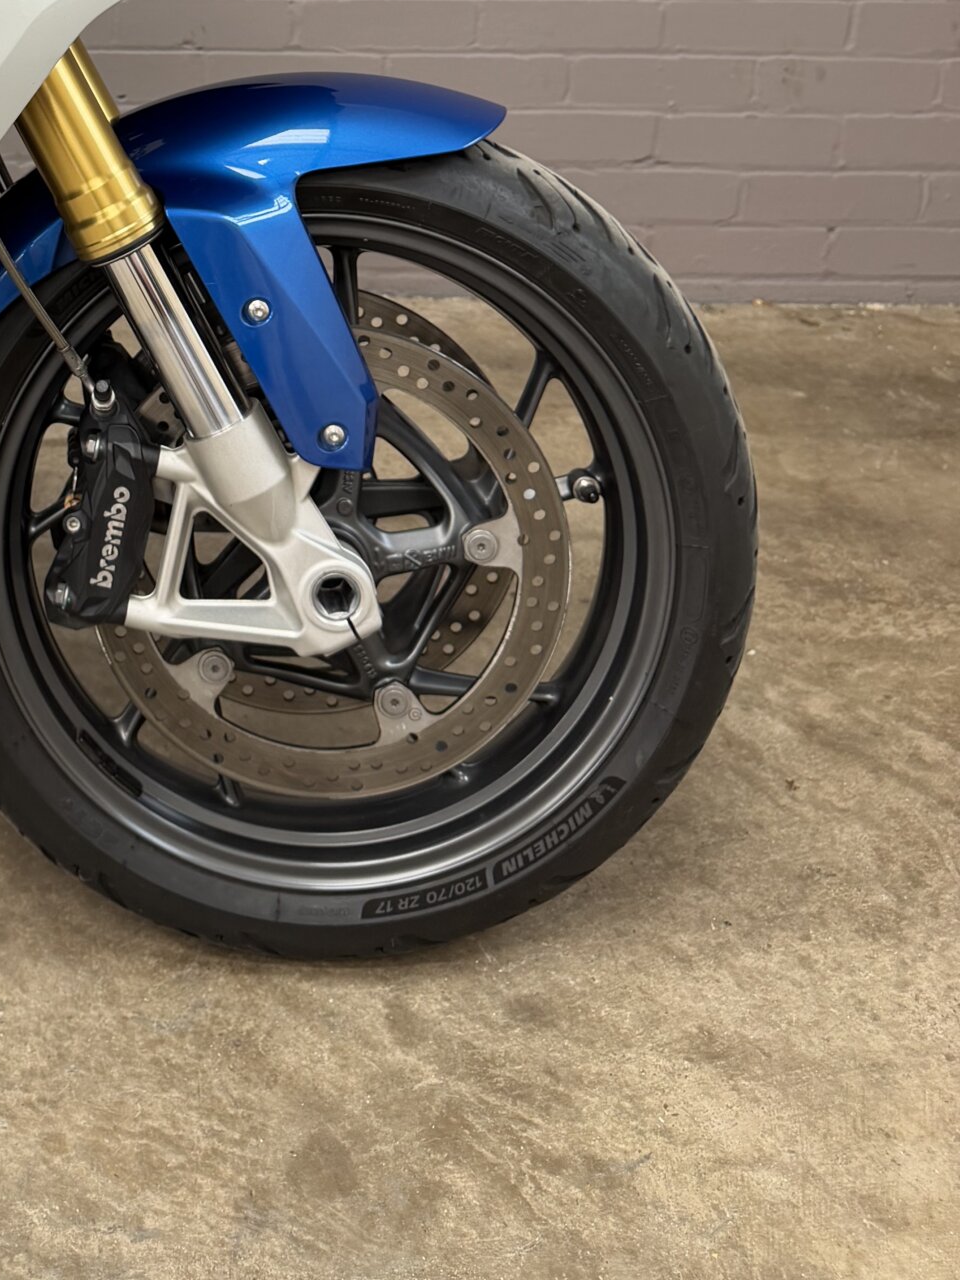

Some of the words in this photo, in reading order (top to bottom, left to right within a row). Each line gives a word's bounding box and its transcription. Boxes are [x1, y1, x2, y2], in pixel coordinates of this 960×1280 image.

[89, 486, 130, 589] brembo
[501, 803, 593, 876] MICHELIN
[398, 895, 420, 911] ZR
[426, 874, 483, 904] 120/70
[375, 901, 393, 915] 17
